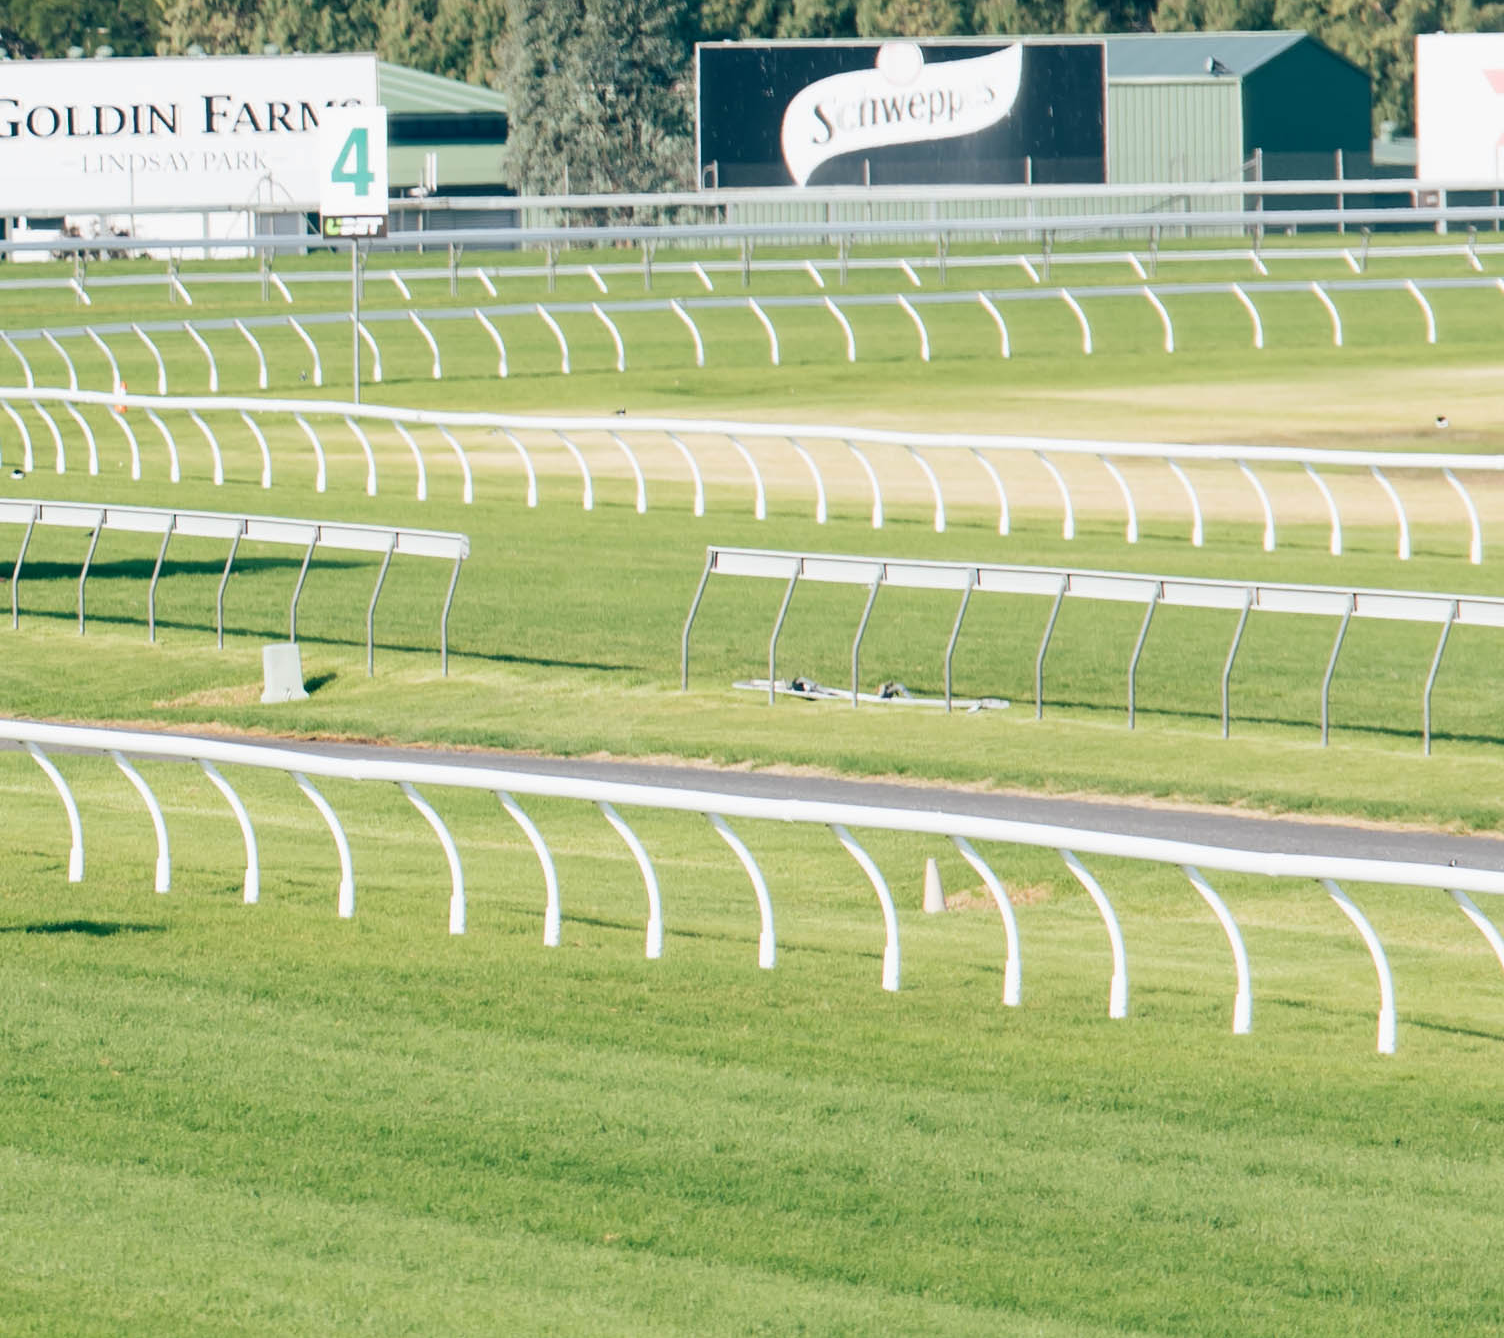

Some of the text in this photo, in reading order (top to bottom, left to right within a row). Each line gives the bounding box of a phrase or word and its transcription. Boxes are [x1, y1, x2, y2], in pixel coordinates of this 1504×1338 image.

[82, 150, 268, 173] LINDSAY PARK
[331, 128, 375, 196] 4
